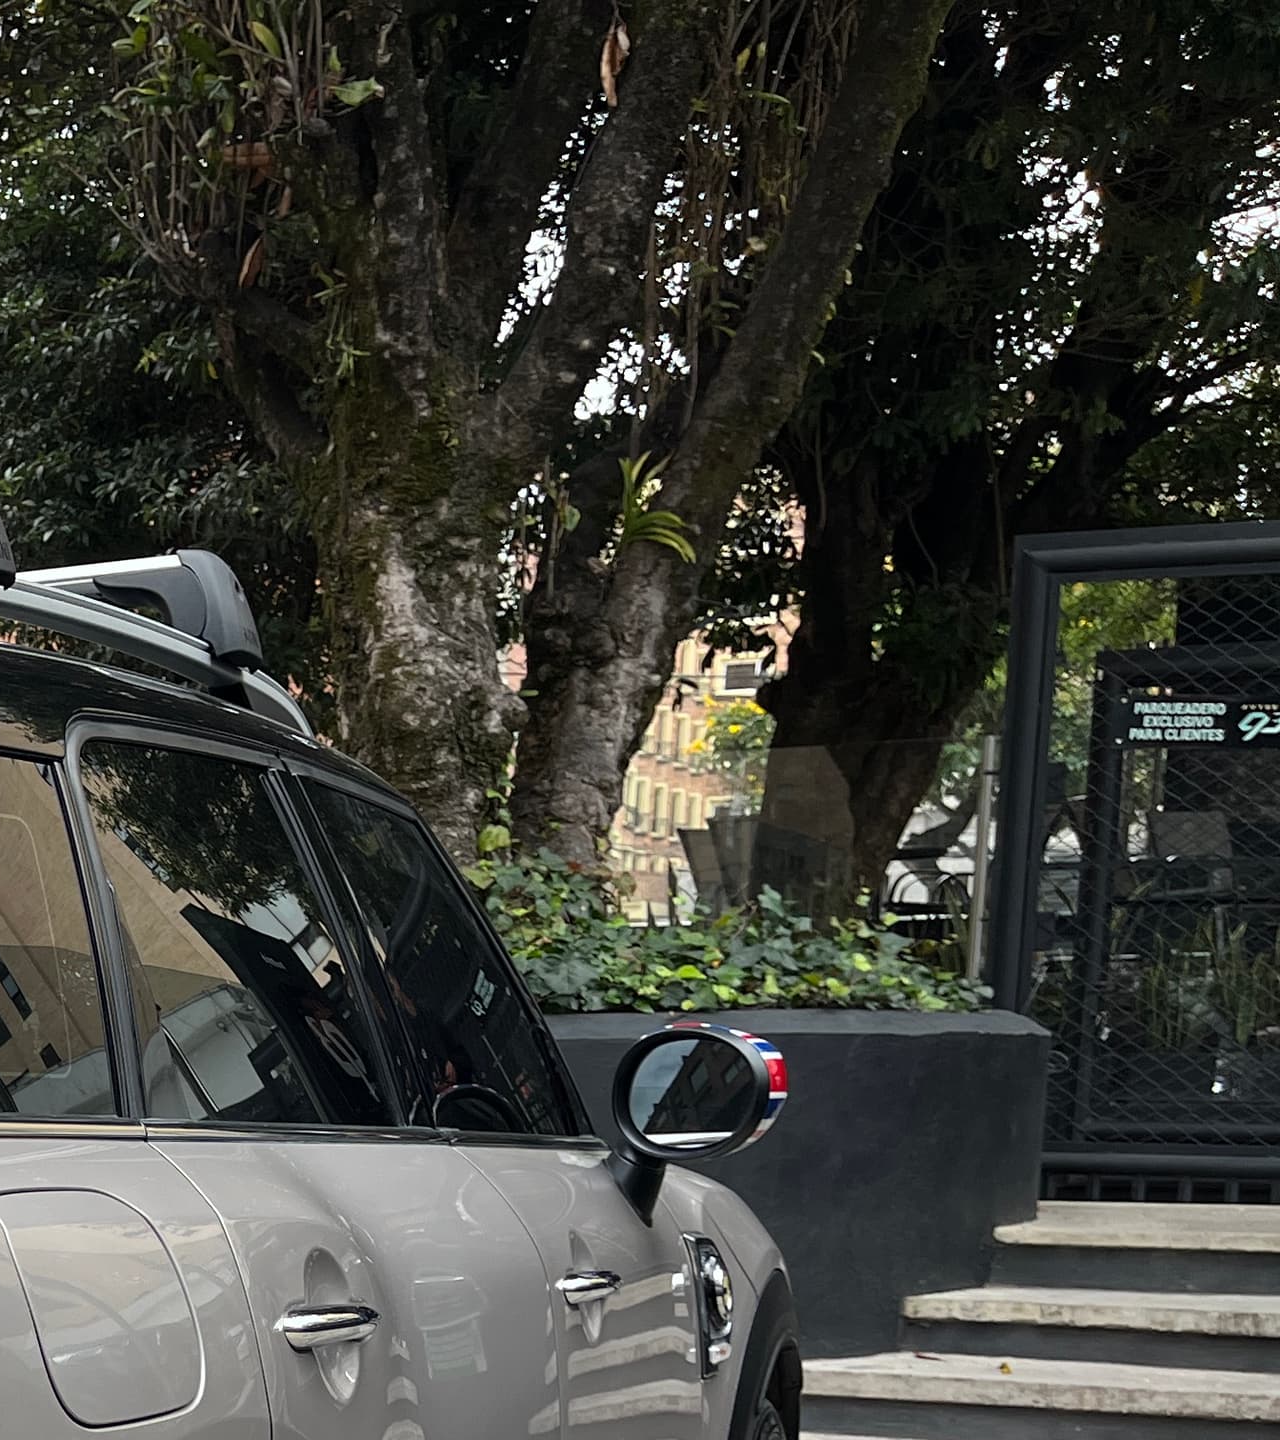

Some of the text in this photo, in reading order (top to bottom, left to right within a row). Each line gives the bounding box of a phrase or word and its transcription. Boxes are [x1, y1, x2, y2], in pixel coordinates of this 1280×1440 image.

[1133, 702, 1227, 715] PARQUEADERO
[1142, 716, 1214, 727] EXCLUSIVO
[1128, 728, 1225, 741] PARA CLIENTES
